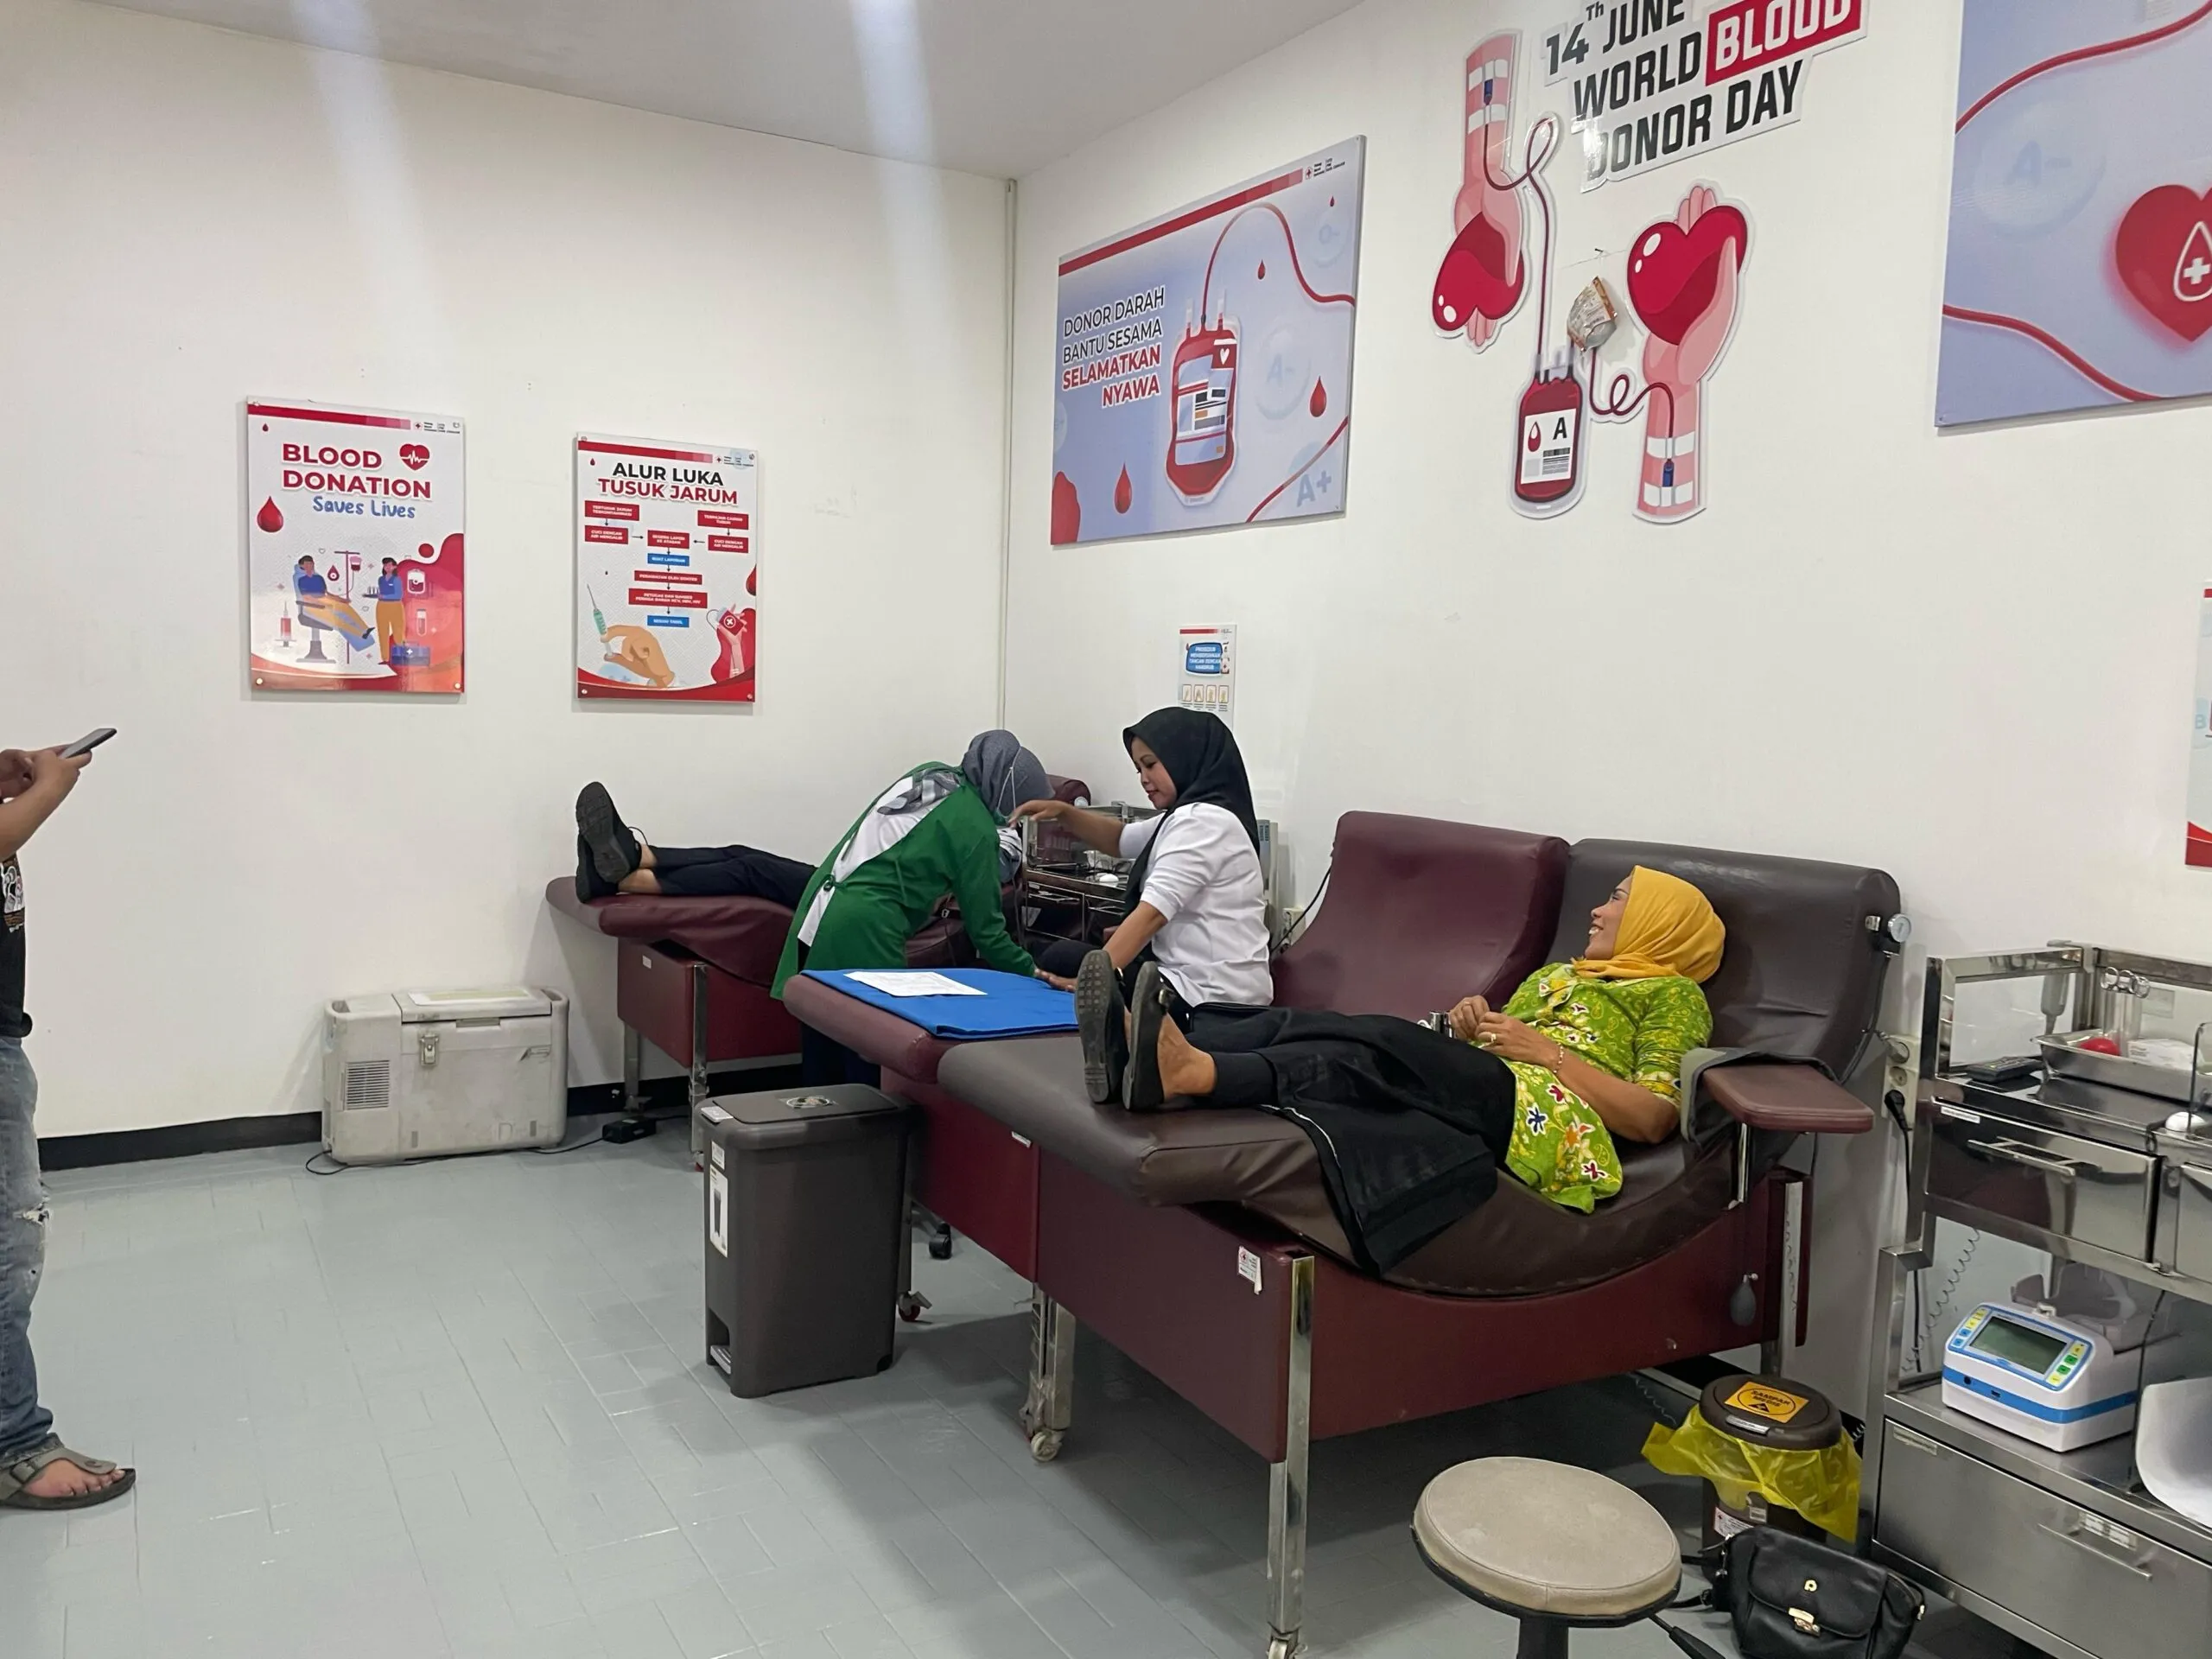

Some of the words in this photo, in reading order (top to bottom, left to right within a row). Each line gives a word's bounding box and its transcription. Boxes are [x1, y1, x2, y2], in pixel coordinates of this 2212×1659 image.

[1603, 0, 1685, 54] JUNE
[1573, 31, 1701, 121] WORLD
[1586, 93, 1713, 181] DONOR
[1726, 59, 1803, 135] DAY
[1064, 306, 1111, 338] DONOR
[1115, 287, 1164, 321] DARAH
[1063, 335, 1104, 364] BANTU
[1107, 318, 1162, 351] SESAMA
[1063, 344, 1161, 390] SELAMATKAN
[1103, 374, 1160, 407] NYAWA
[1552, 416, 1568, 441] A
[283, 443, 383, 469] BLOOD
[283, 469, 431, 499] DONATION
[612, 462, 666, 480] ALUR
[672, 467, 724, 486] LUKA
[313, 495, 365, 516] Saves
[371, 499, 416, 519] Lives
[598, 478, 665, 499] TUSUK
[670, 485, 737, 505] JARUM
[1751, 1390, 1790, 1405] SAMPAH
